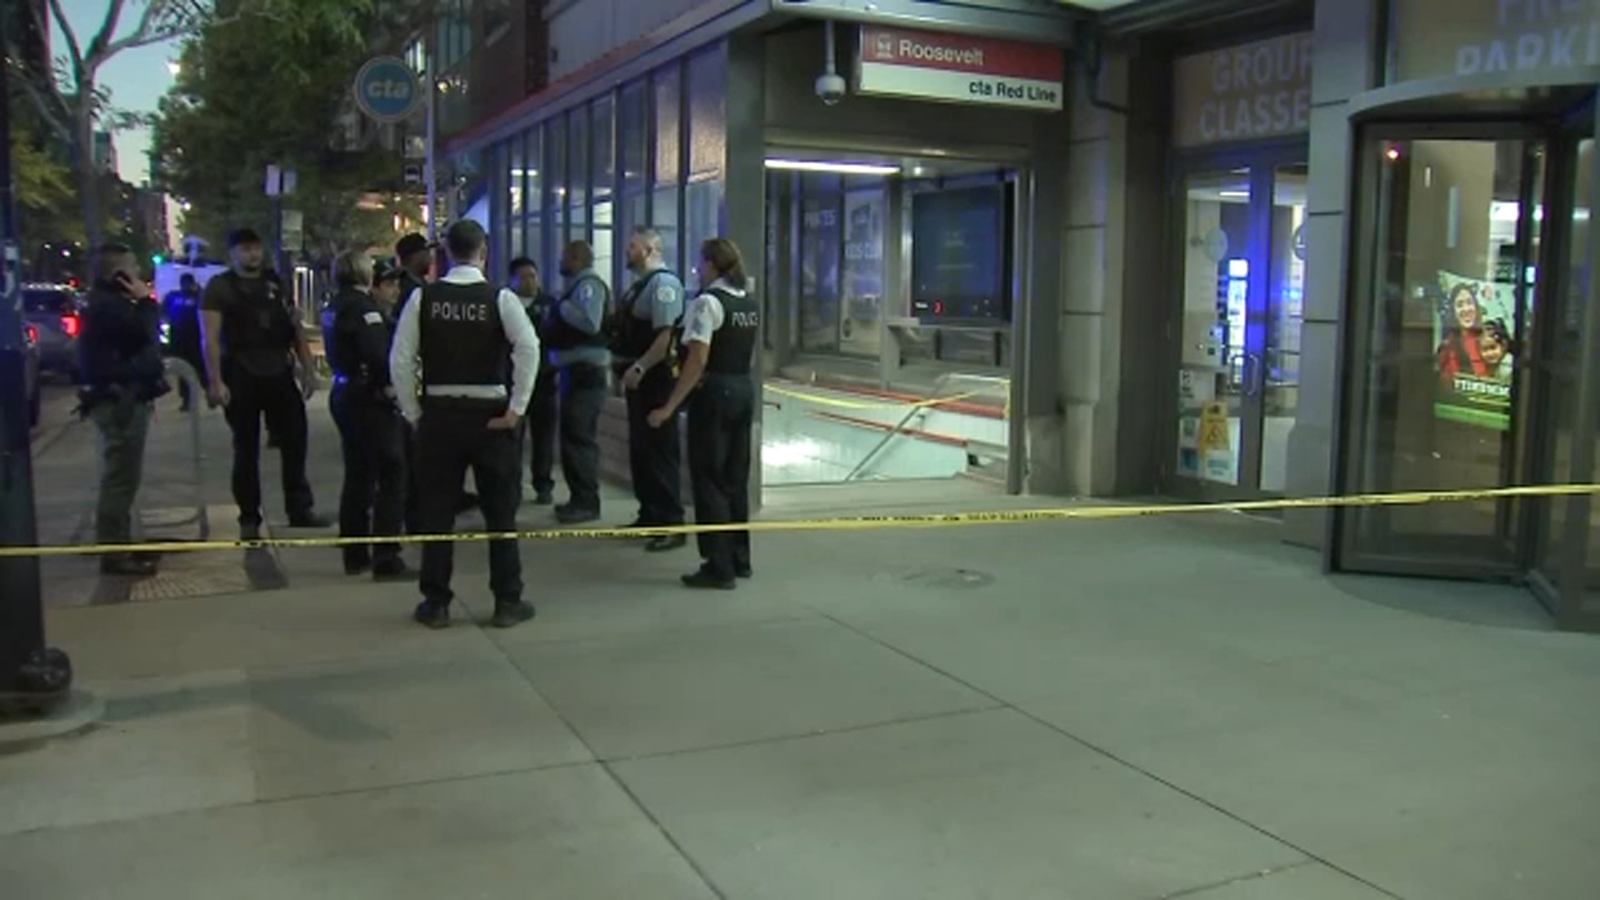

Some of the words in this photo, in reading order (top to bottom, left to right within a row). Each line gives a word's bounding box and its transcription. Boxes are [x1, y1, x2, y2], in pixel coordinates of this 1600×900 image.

[901, 40, 984, 66] Roosevelt
[367, 79, 409, 98] cta
[969, 81, 992, 97] cta
[996, 82, 1024, 99] Red
[1028, 86, 1057, 103] Line
[1199, 88, 1309, 141] CLASSE
[432, 302, 487, 320] POLICE
